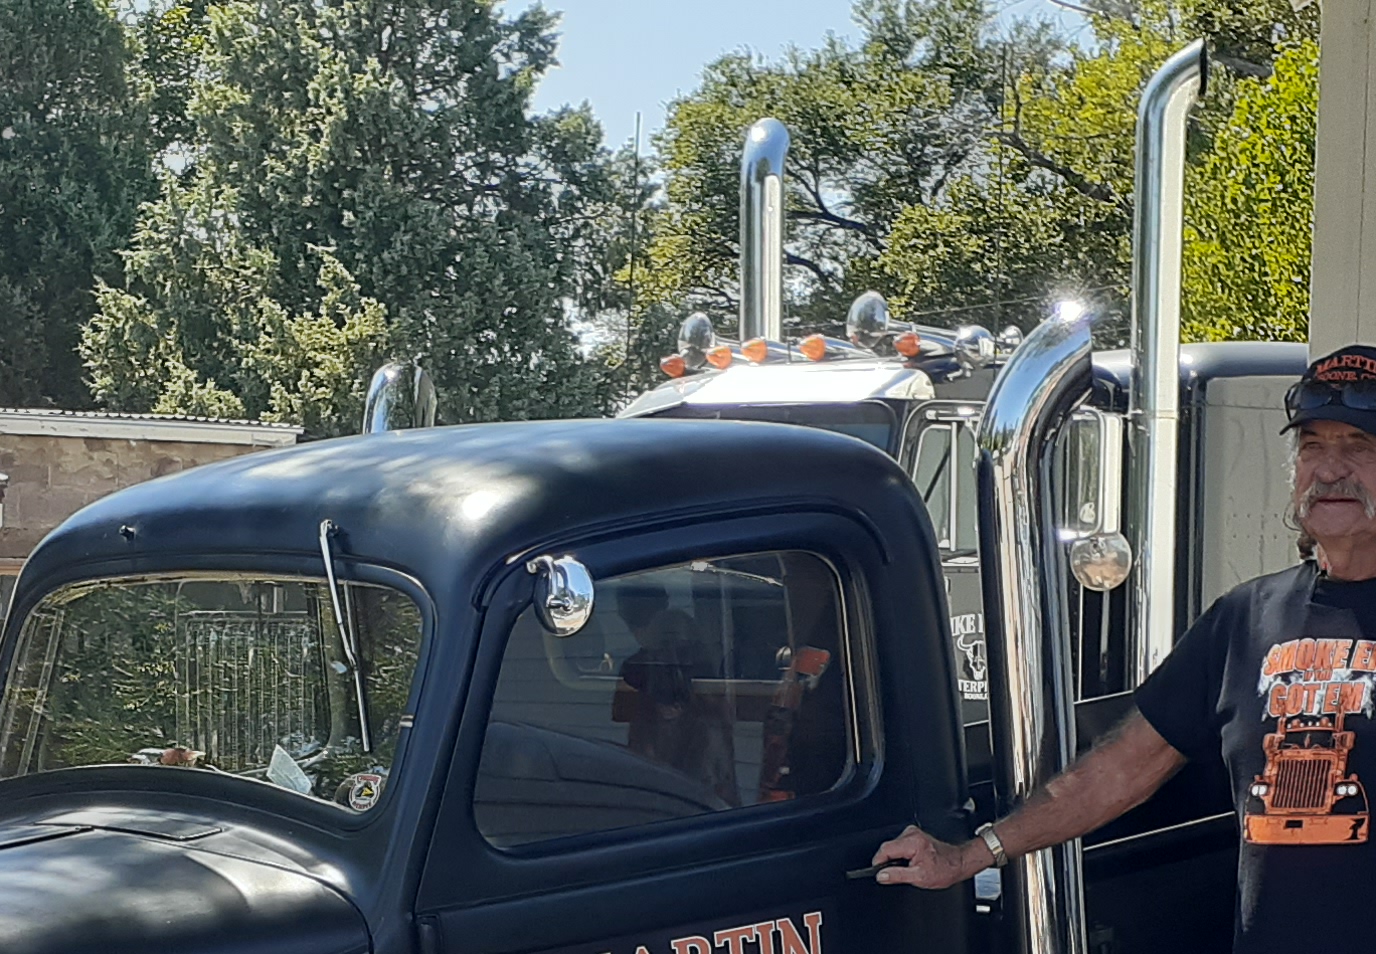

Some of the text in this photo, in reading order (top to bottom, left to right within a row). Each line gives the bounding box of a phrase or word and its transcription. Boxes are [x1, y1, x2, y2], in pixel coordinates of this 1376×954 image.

[1263, 638, 1353, 676] SMOKE
[1268, 681, 1366, 717] GOT EM
